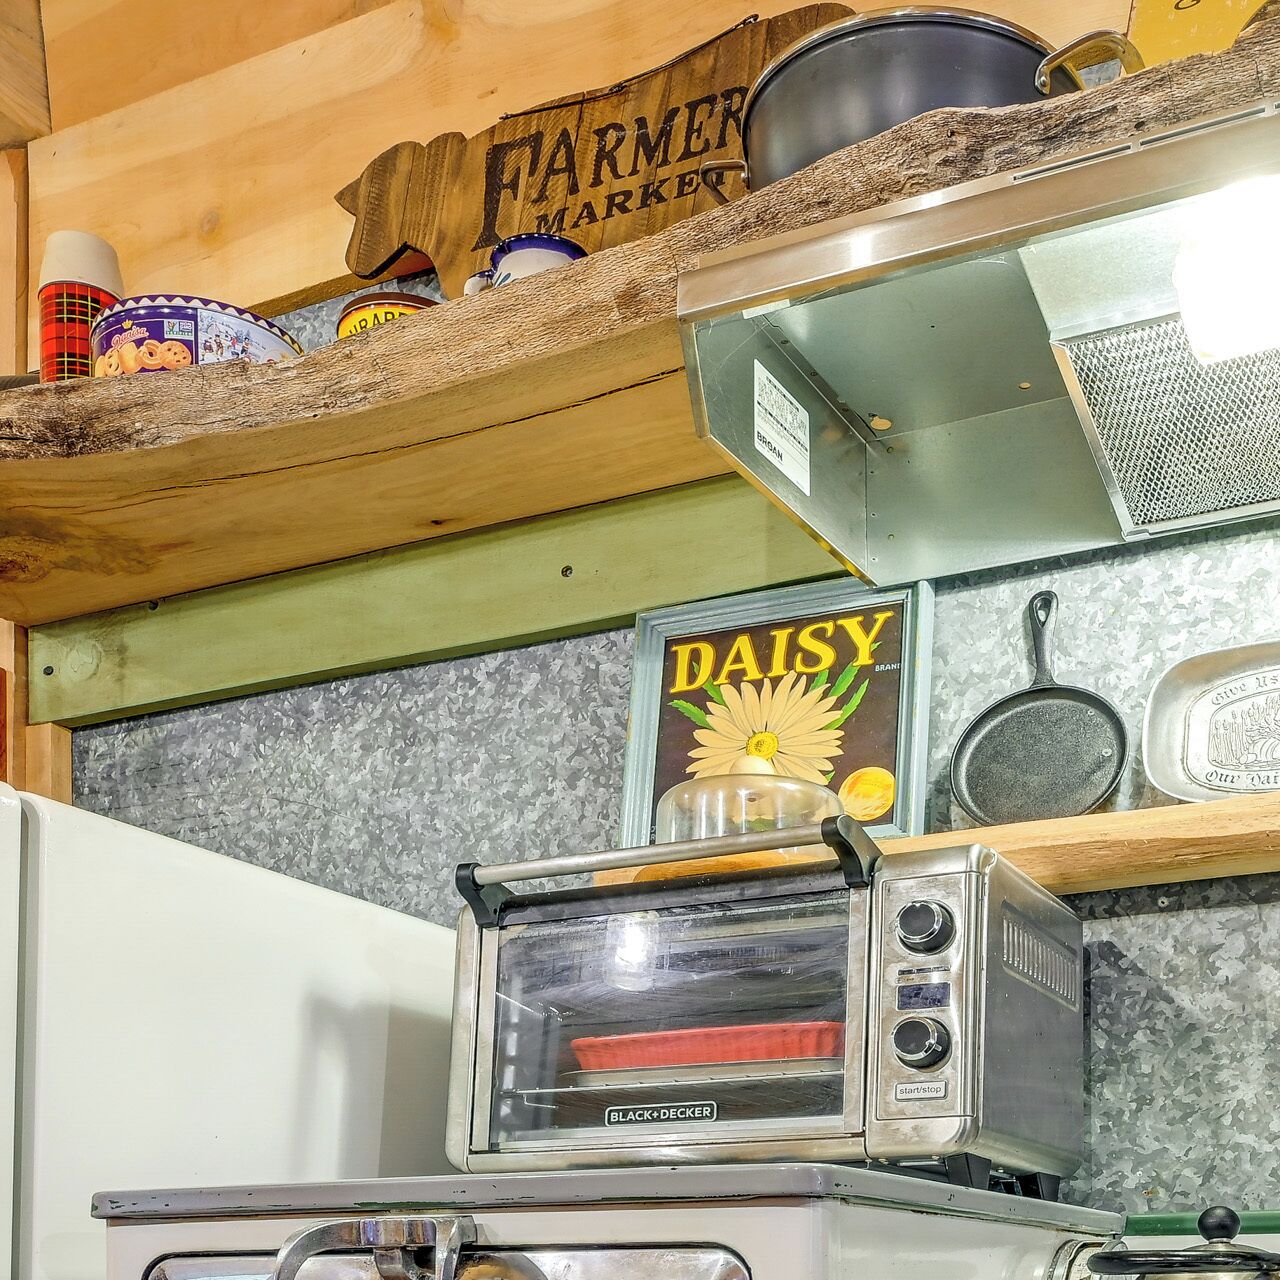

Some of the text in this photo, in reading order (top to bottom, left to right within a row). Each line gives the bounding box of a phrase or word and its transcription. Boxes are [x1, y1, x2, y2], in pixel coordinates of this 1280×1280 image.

[111, 326, 149, 348] Danisa
[756, 430, 784, 462] BROAN
[670, 611, 894, 694] DAISY
[1211, 682, 1248, 706] Give
[1205, 770, 1241, 784] Our
[899, 1084, 942, 1096] start/stop
[610, 1106, 711, 1122] BLACK+DECKER
